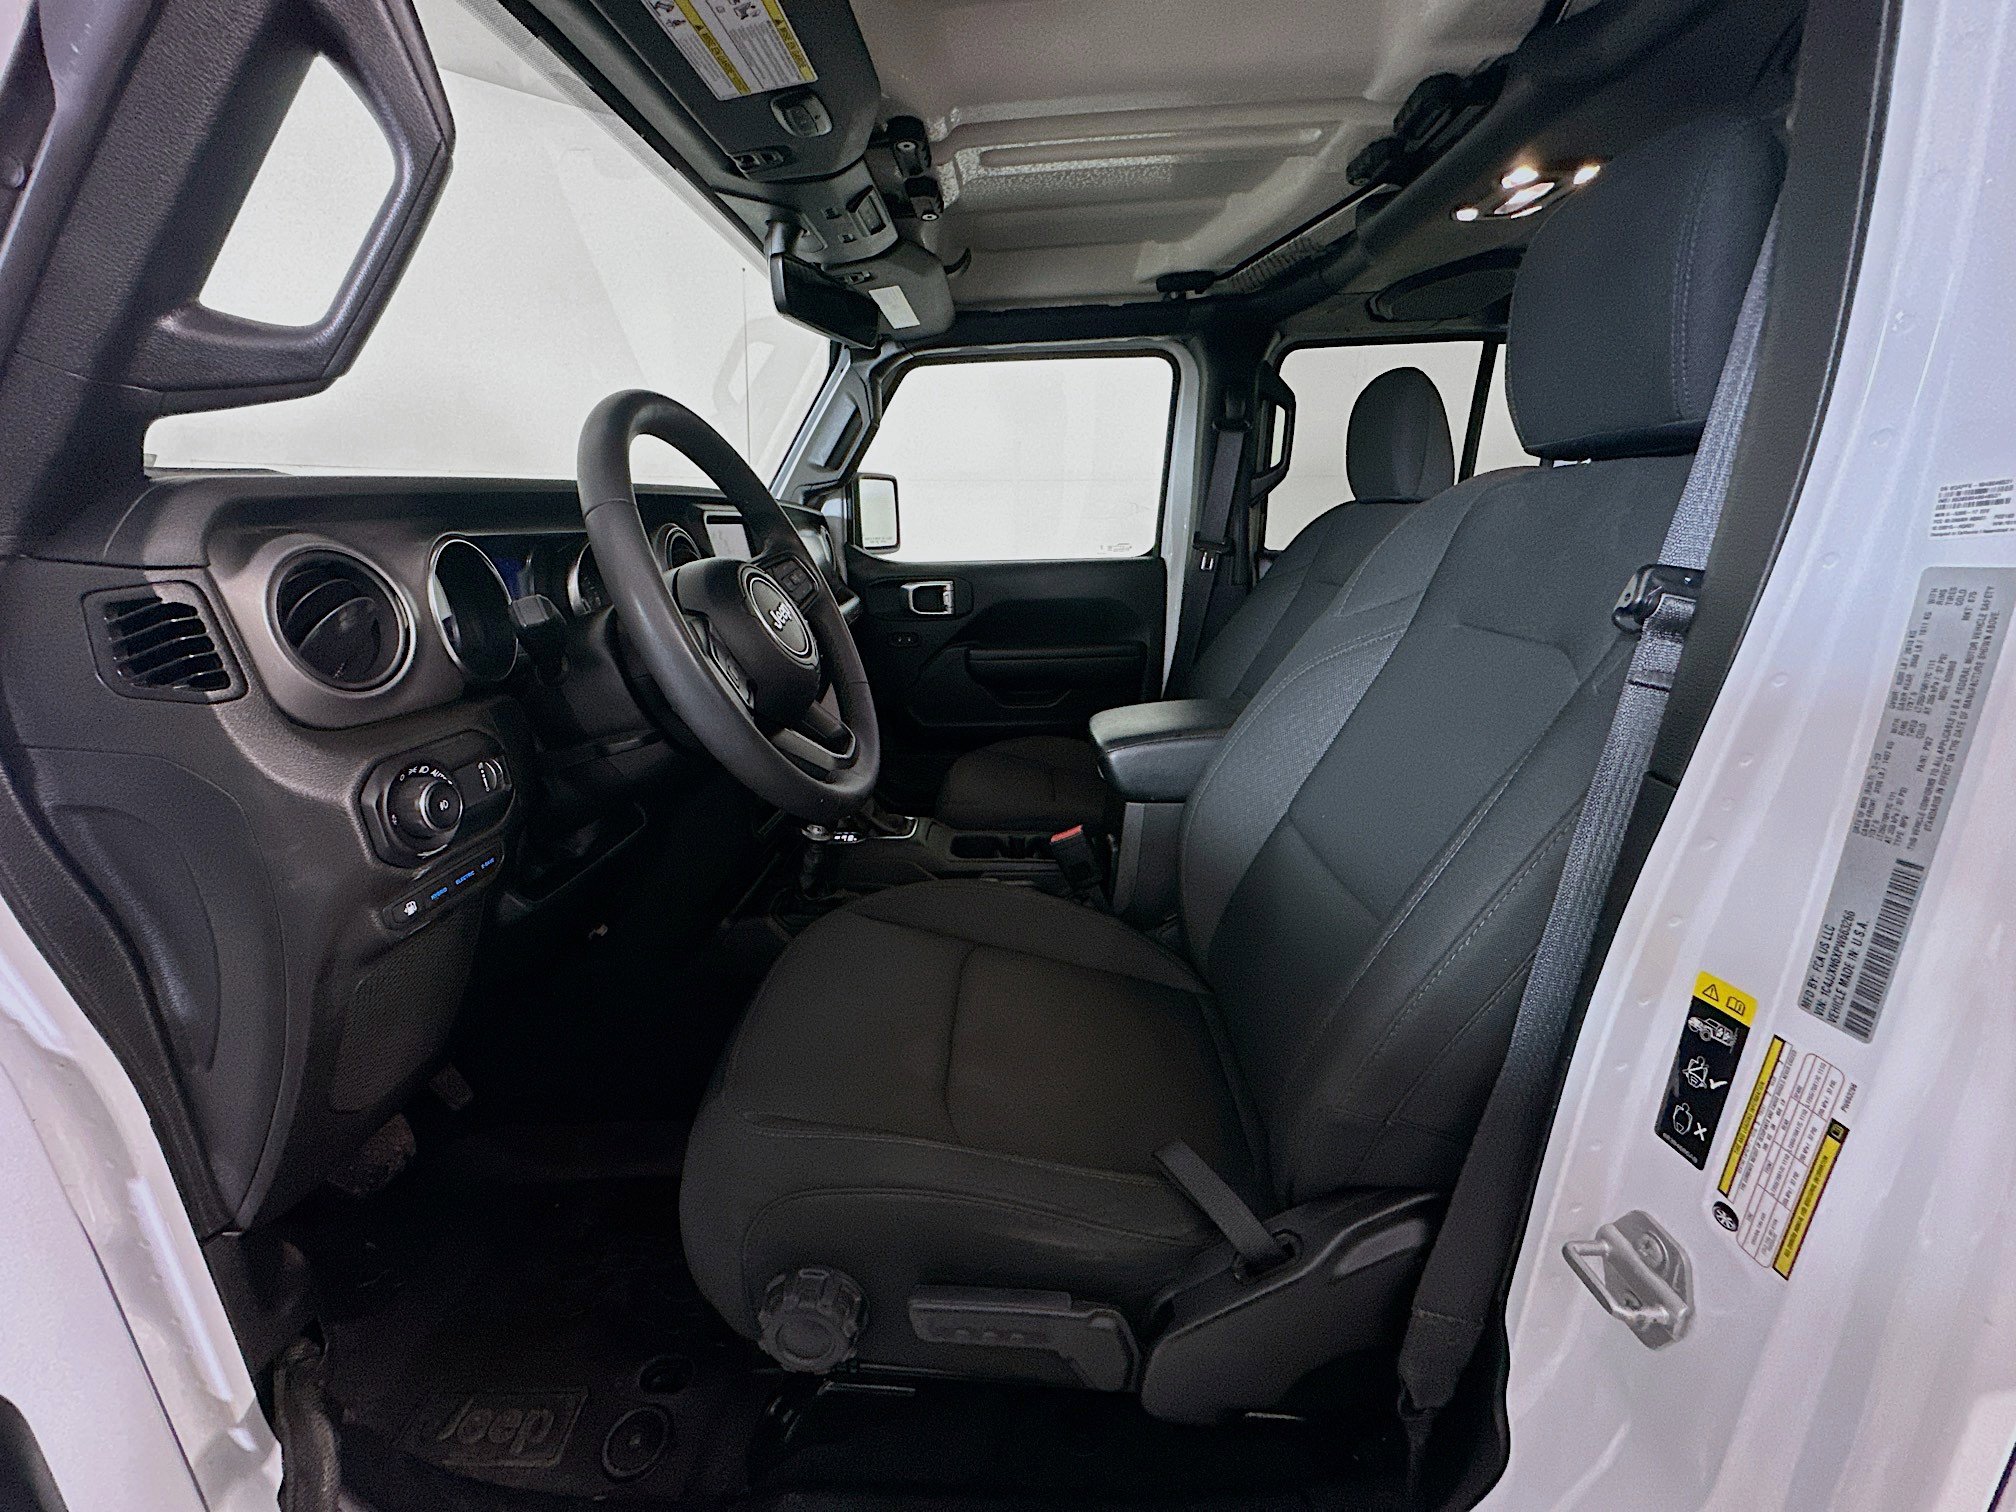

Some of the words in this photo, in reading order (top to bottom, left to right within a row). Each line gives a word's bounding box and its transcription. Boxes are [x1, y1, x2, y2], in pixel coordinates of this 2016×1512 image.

[769, 602, 792, 630] Jeep
[1822, 924, 1835, 940] LLC
[1818, 941, 1829, 954] US
[1812, 956, 1825, 972] FCA
[1801, 990, 1814, 1009] MFD
[1827, 988, 1846, 1023] VEHICLE
[1838, 962, 1854, 987] MADE
